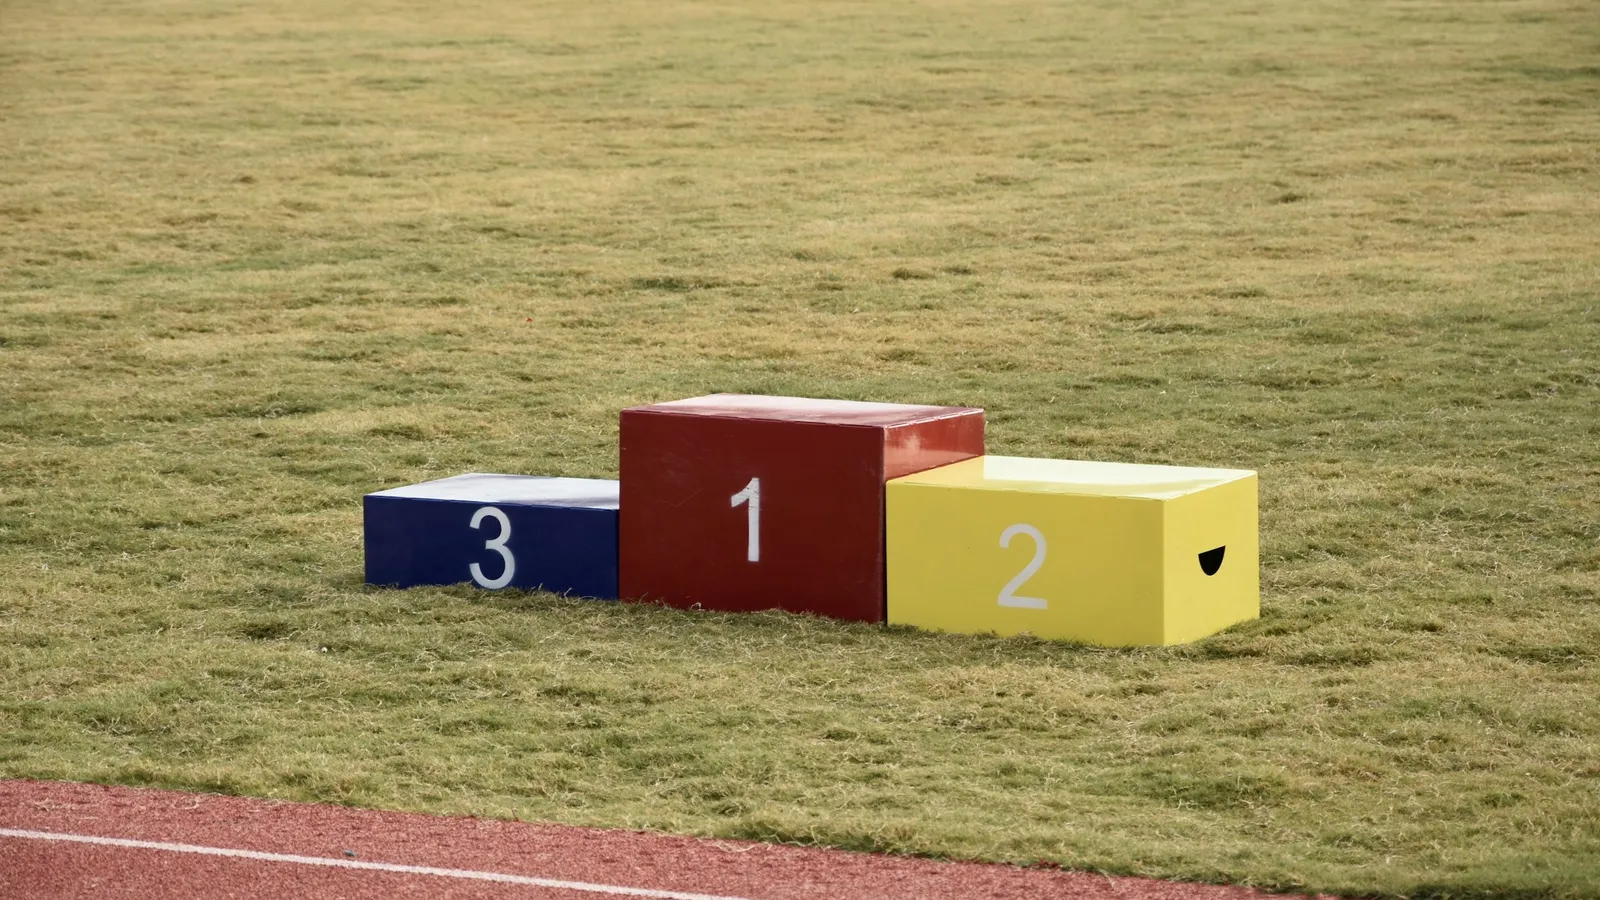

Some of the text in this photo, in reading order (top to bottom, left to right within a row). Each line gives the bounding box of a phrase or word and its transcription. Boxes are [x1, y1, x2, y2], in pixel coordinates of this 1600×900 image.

[469, 506, 516, 590] 3
[730, 477, 761, 562] 1
[997, 523, 1048, 609] 2
